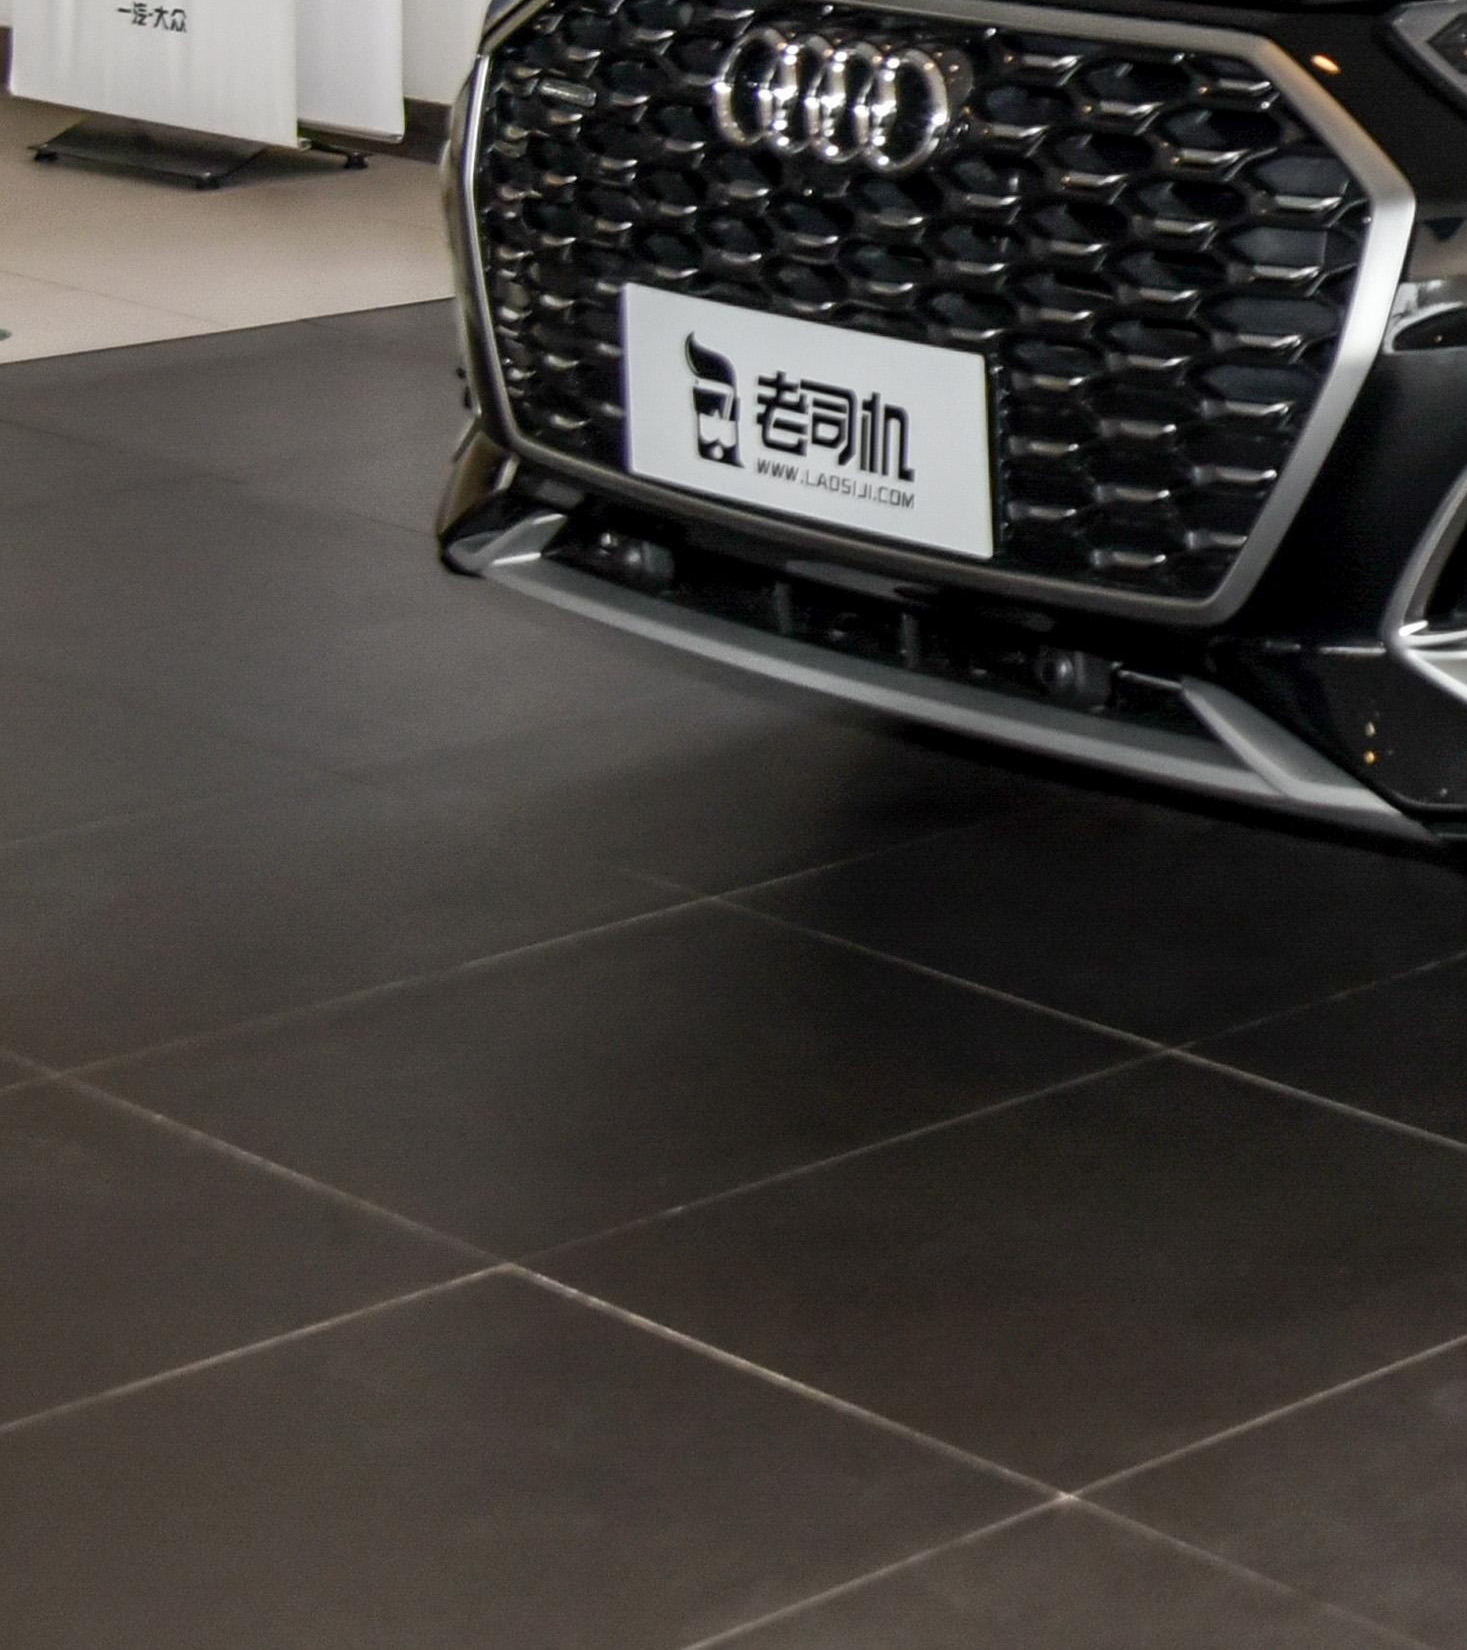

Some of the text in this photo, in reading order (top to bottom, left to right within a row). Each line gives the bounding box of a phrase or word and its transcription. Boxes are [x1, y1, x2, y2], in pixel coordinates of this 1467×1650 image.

[756, 370, 916, 483] 老司机
[756, 457, 916, 510] WWW.LAOSIJI.COM
